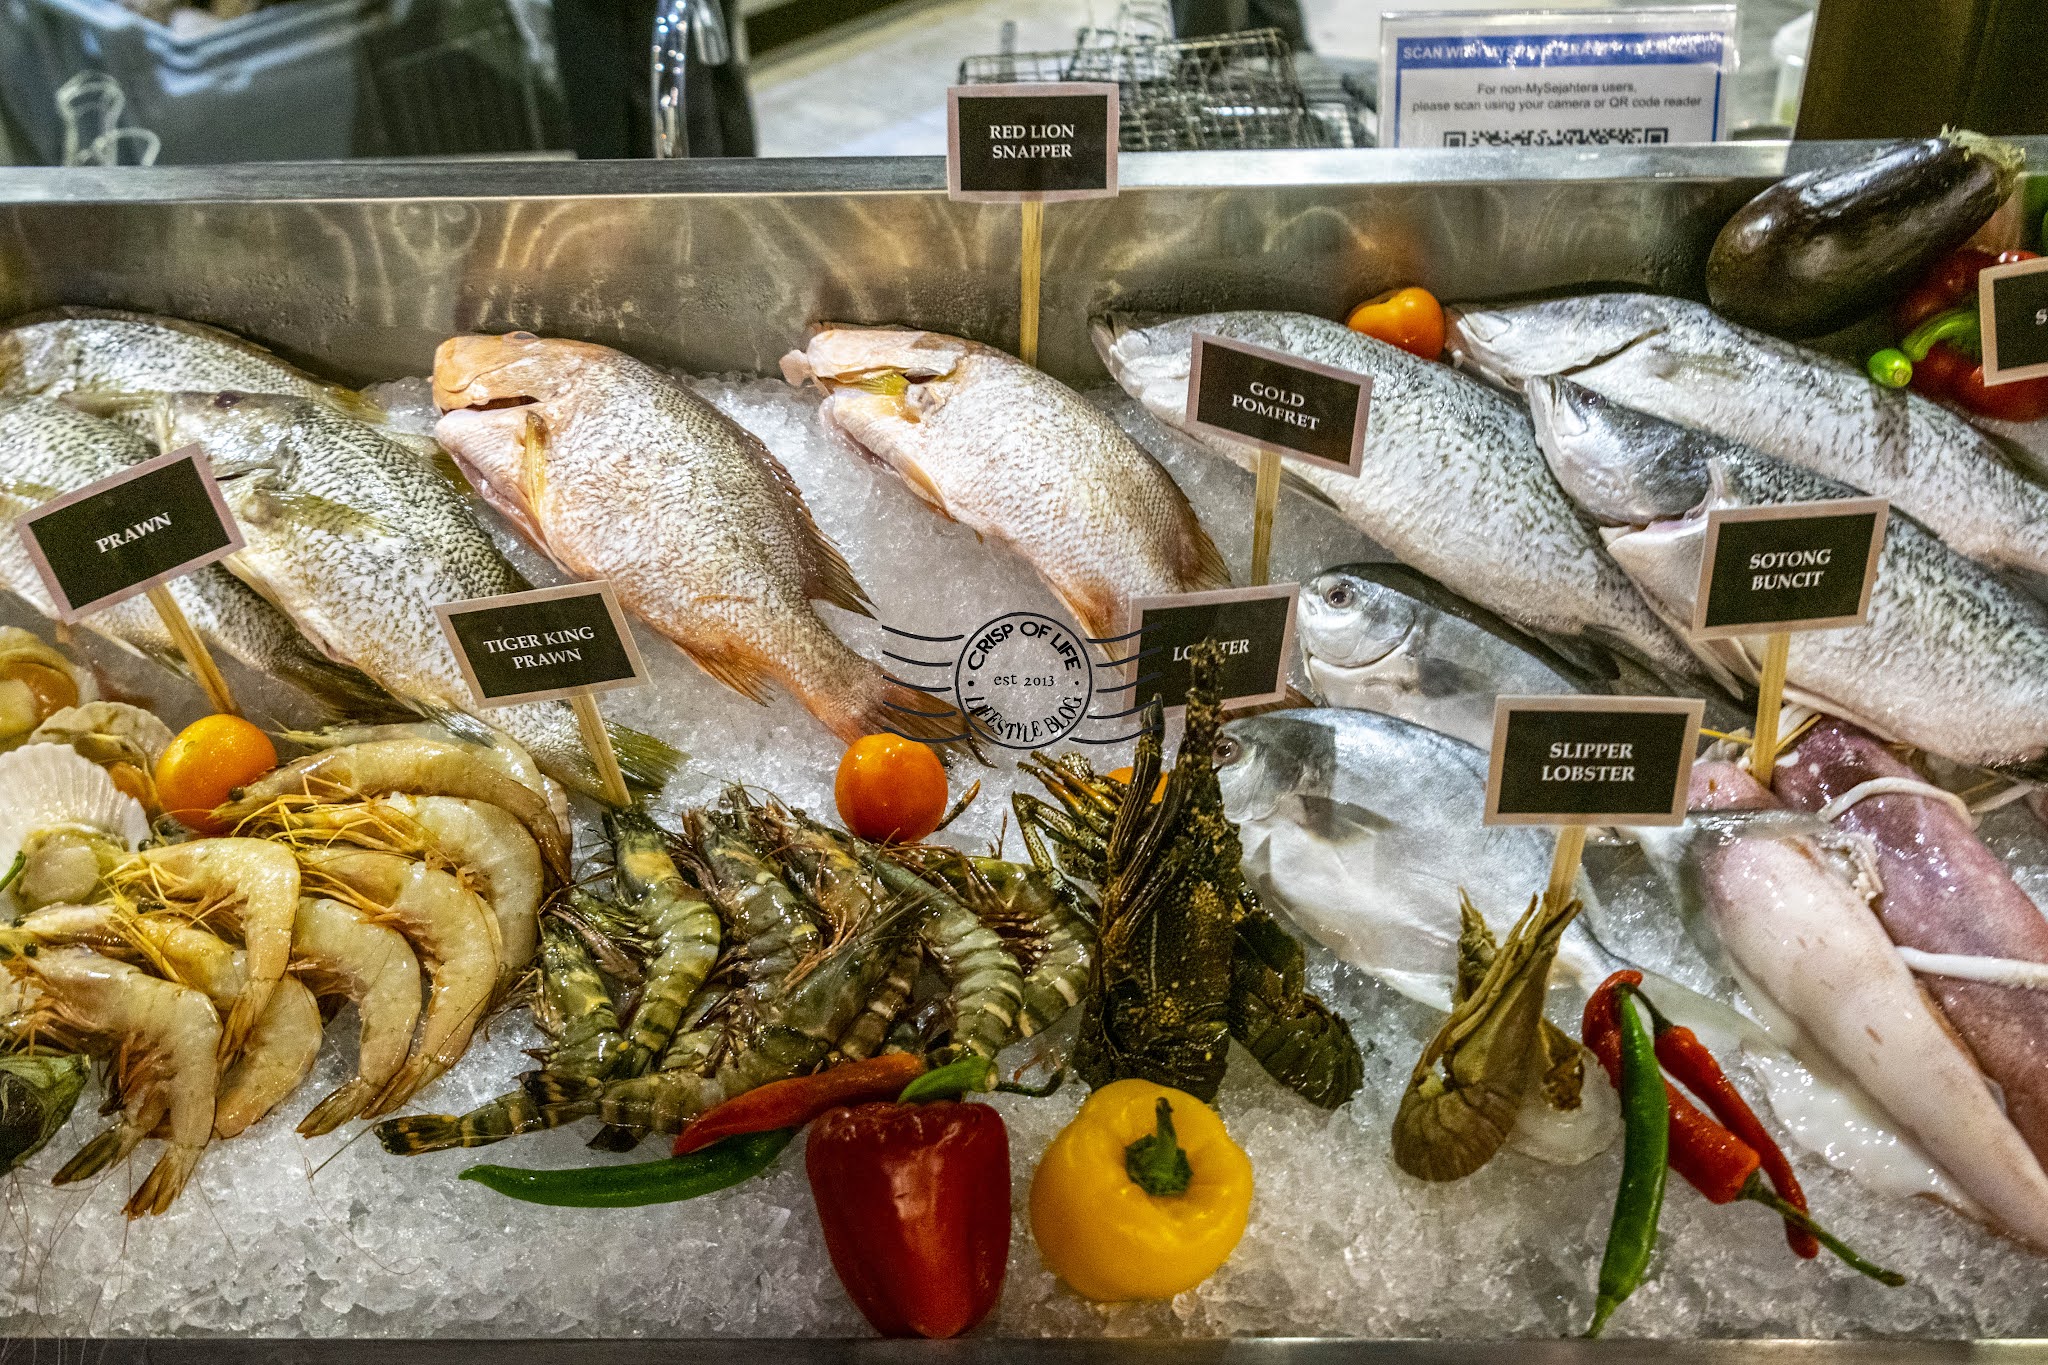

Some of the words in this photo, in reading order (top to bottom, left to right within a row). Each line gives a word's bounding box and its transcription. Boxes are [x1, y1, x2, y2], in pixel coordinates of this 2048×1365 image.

[1402, 45, 1442, 59] SCAN
[1477, 82, 1496, 95] For
[1412, 100, 1450, 113] please
[1454, 101, 1481, 111] scan
[1484, 99, 1516, 112] using
[1519, 100, 1543, 112] your
[1547, 99, 1591, 109] camera
[1594, 99, 1605, 109] or
[1609, 96, 1629, 108] QR
[1632, 96, 1661, 108] code
[1663, 96, 1701, 107] reader
[989, 125, 1026, 139] RED
[1030, 124, 1075, 139] LION
[992, 143, 1073, 159] SNAPPER
[1250, 381, 1305, 408] GOLD
[1231, 393, 1320, 430] POMFRET
[95, 511, 173, 553] PRAWN
[1749, 548, 1832, 570] SOTONG
[1751, 570, 1825, 591] BUNCIT
[483, 634, 542, 654] TIGER
[543, 626, 595, 646] KING
[1172, 638, 1250, 662] LOTER
[512, 648, 583, 670] PRAWN
[1549, 742, 1634, 760] SLIPPER
[1541, 765, 1636, 782] LOBSTER
